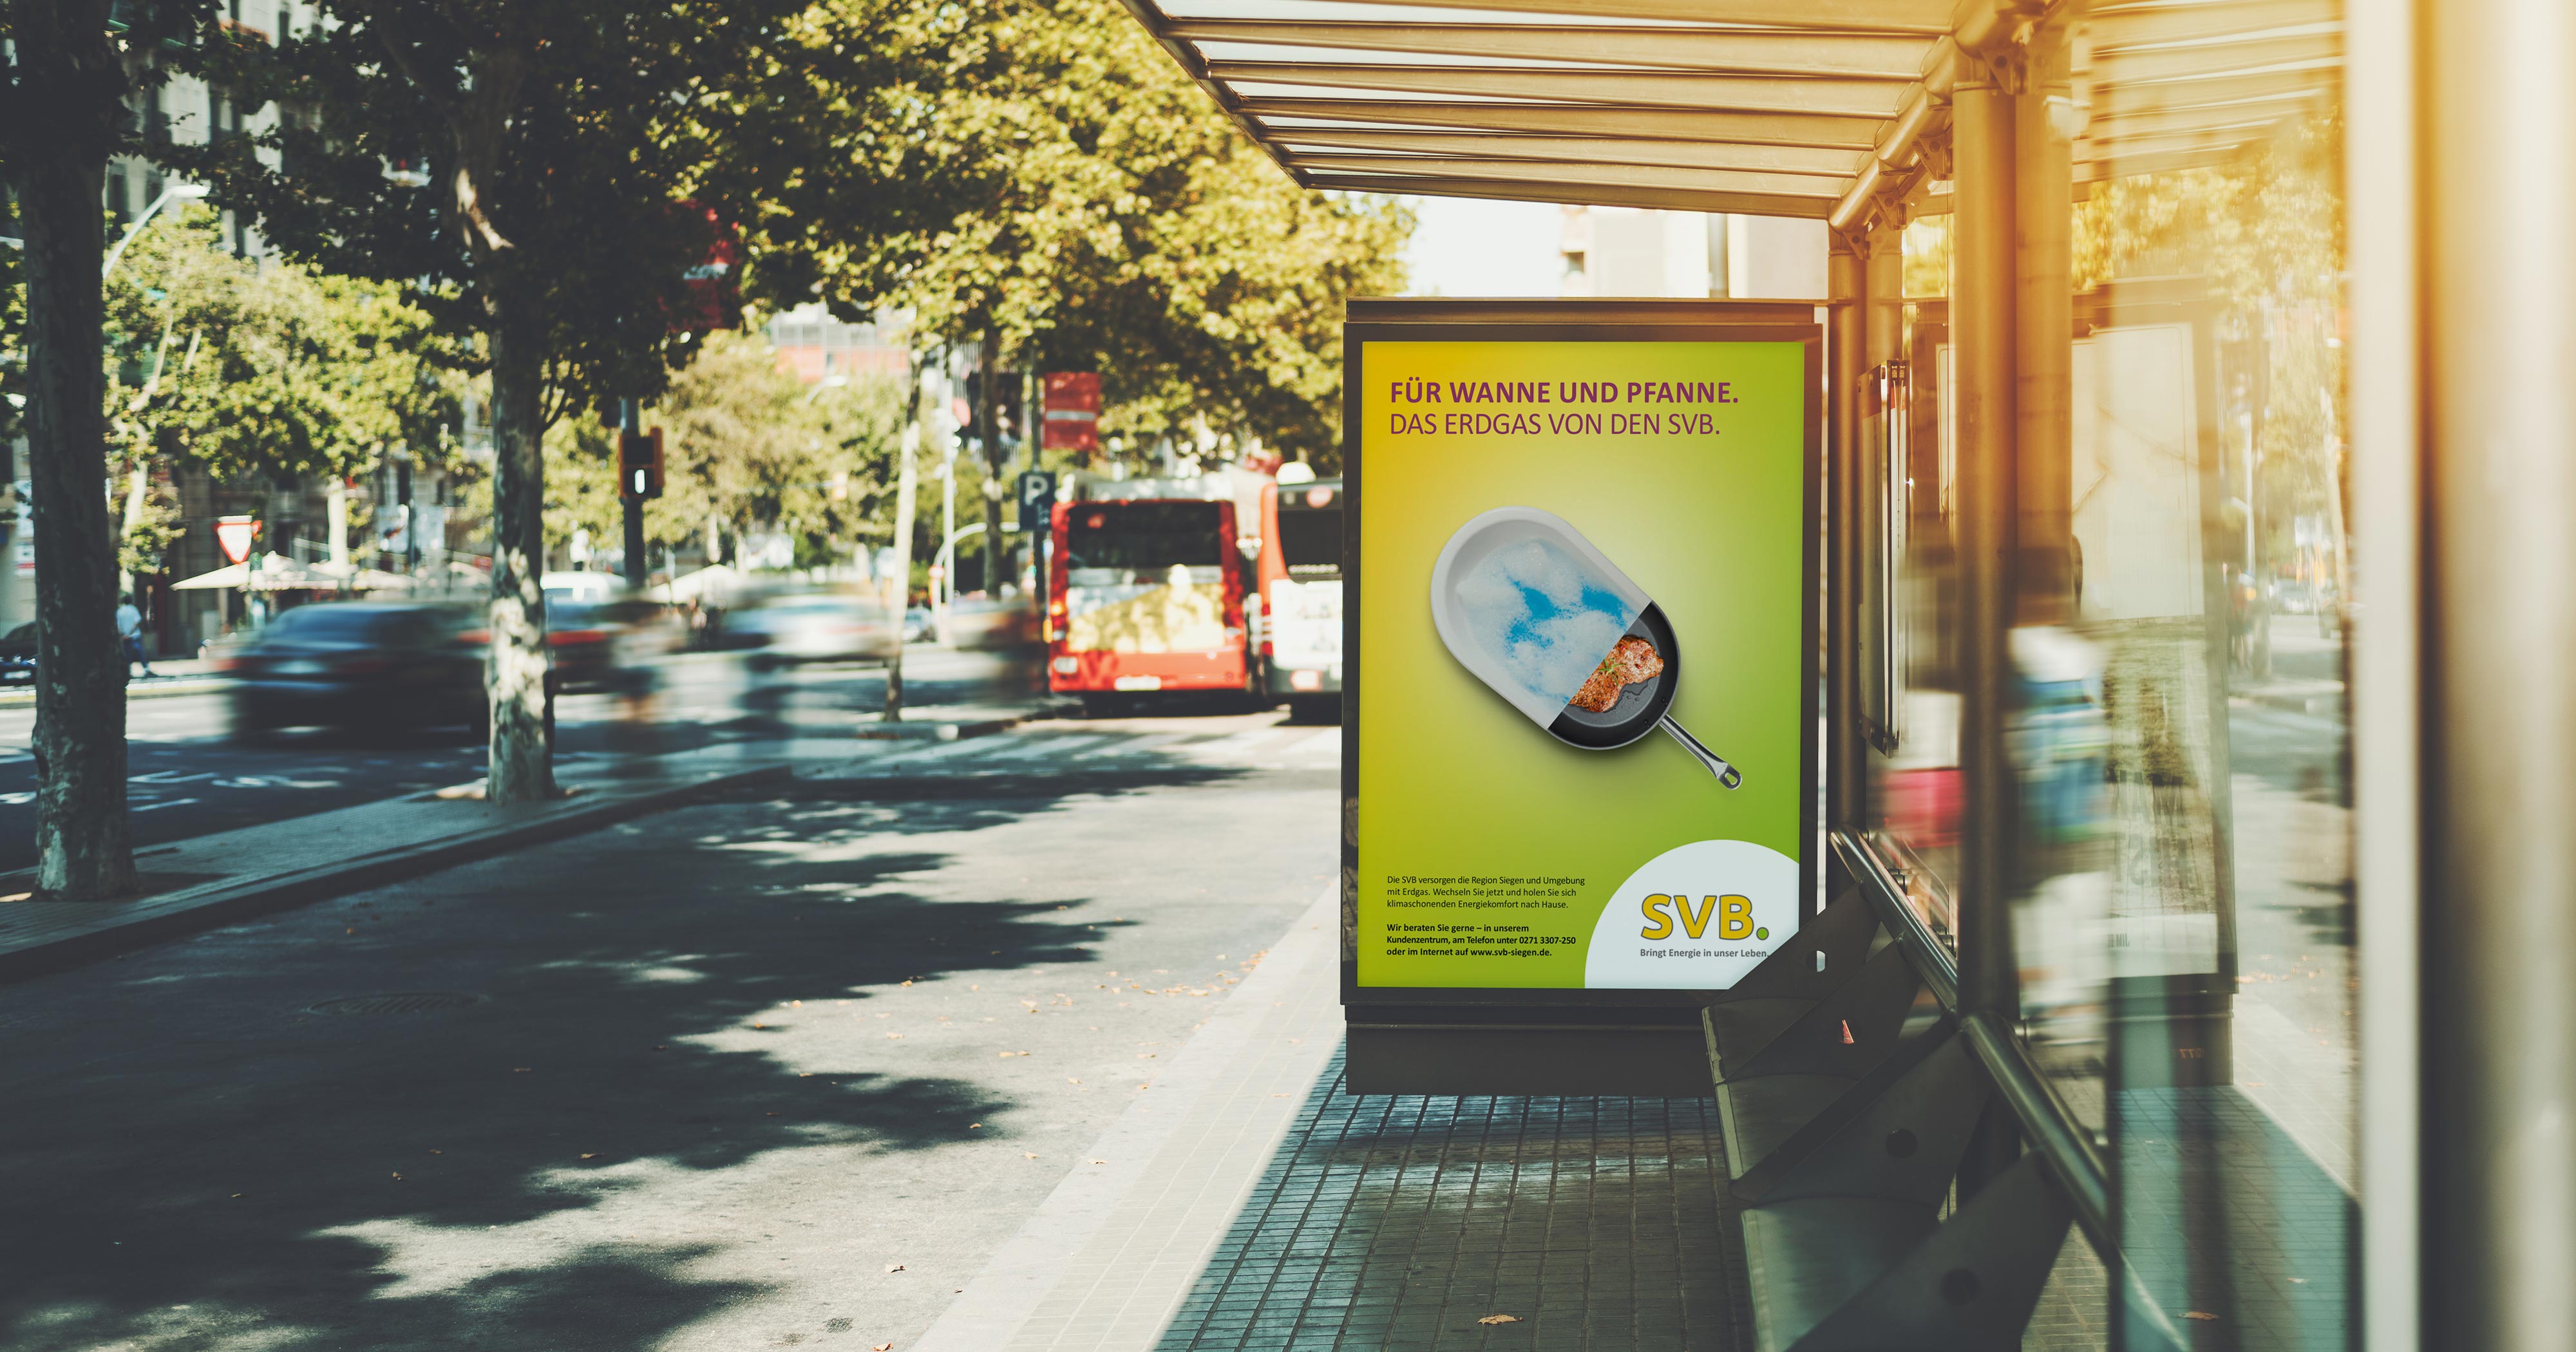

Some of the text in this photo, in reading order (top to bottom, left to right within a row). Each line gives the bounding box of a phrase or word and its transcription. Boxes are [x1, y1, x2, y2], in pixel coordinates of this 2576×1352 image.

[1391, 377, 1738, 403] FÜR WANNE UND PFANNE.
[1391, 413, 1719, 435] DAS ERDGAS VON DEN SVB.
[1025, 476, 1048, 506] P
[1387, 876, 1585, 886] Die SVB versorgen die Region Siegen und Umgebung
[1403, 888, 1430, 897] Erdgas.
[1432, 888, 1471, 896] Wechseln
[1473, 888, 1484, 896] Sie
[1486, 888, 1504, 897] jetzt
[1506, 888, 1521, 896] und
[1523, 888, 1546, 896] holen
[1561, 888, 1577, 896] sich
[1387, 899, 1456, 908] klimaschonenden
[1458, 900, 1519, 910] Energiekomfort
[1520, 900, 1540, 908] nach
[1641, 894, 1769, 941] SVB.
[1387, 923, 1402, 932] Wir
[1403, 923, 1435, 932] beraten
[1484, 924, 1492, 932] in
[1387, 935, 1451, 945] Kundenzentrum,
[1466, 935, 1495, 944] Telefon
[1540, 936, 1576, 944] 3307-250
[1387, 947, 1406, 955] oder
[1420, 948, 1454, 956] Internet
[1455, 948, 1469, 956] auf
[1470, 948, 1552, 958] www.svb-siegen.de.
[1640, 948, 1667, 959] Bringt
[1669, 948, 1701, 959] Energie
[1703, 948, 1712, 957] in
[1741, 948, 1769, 958] Leben.
